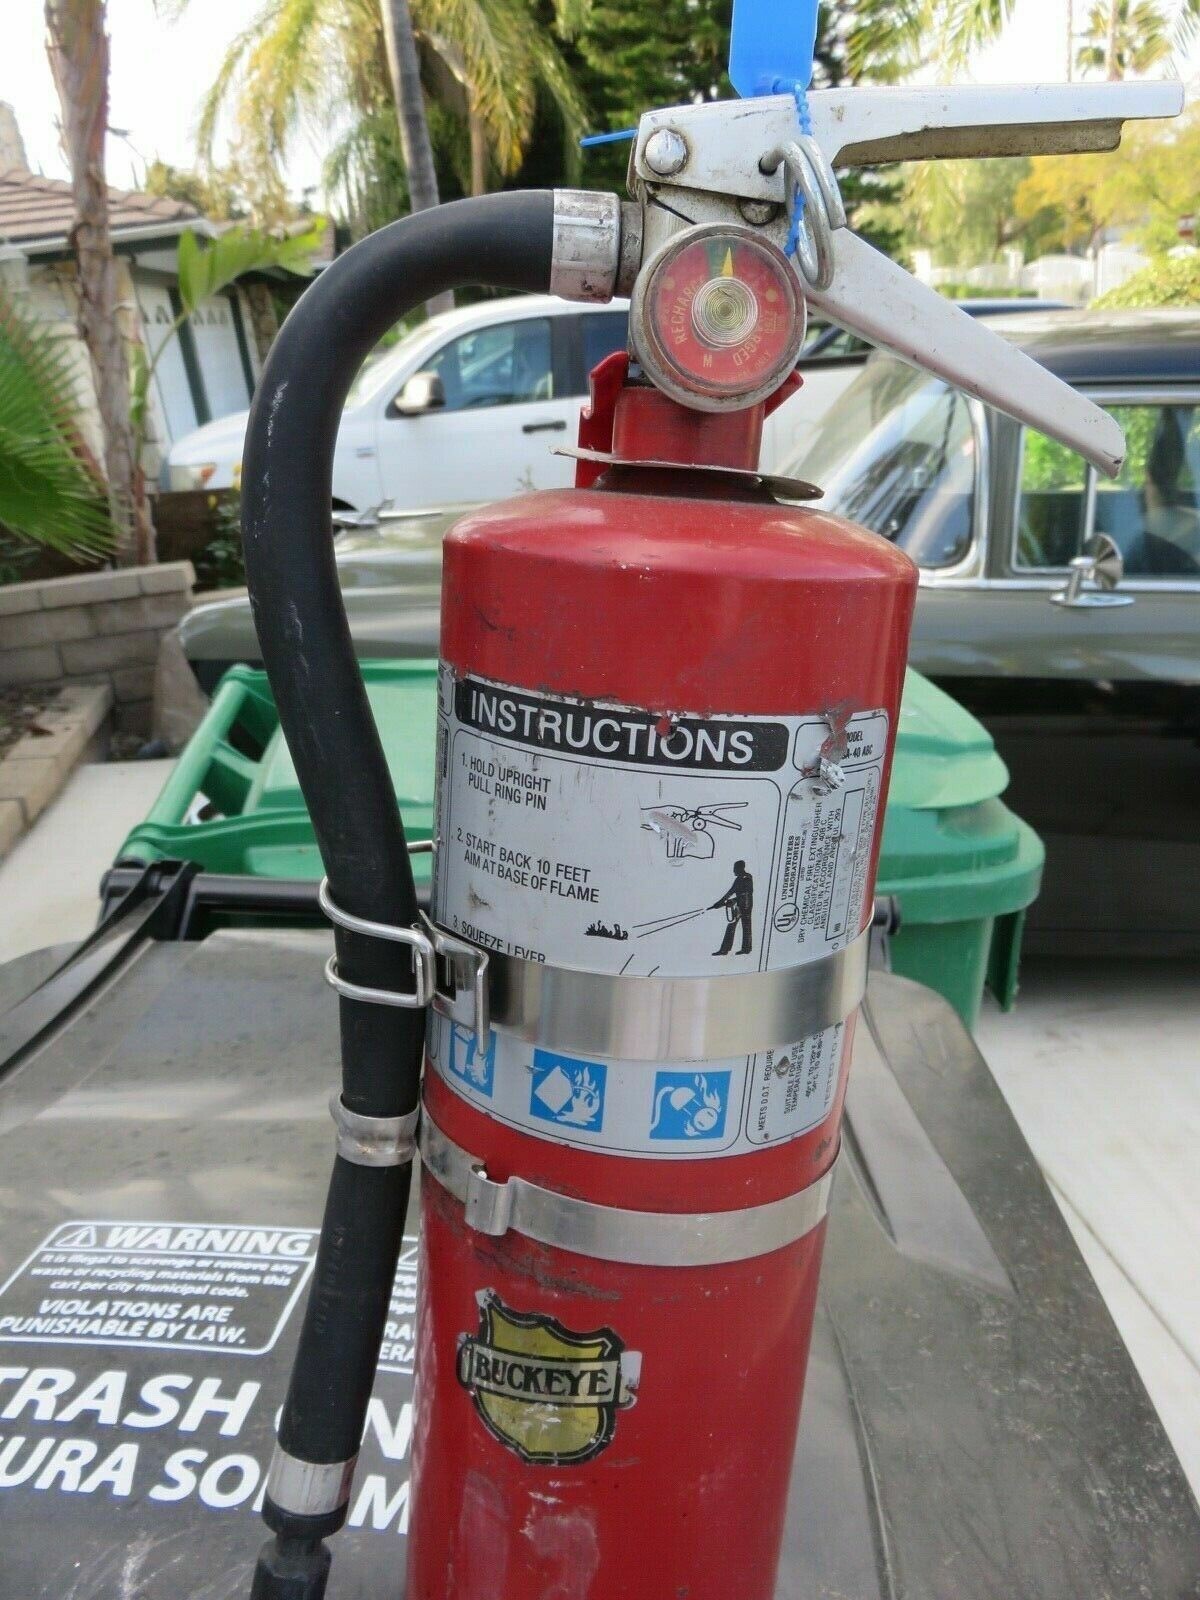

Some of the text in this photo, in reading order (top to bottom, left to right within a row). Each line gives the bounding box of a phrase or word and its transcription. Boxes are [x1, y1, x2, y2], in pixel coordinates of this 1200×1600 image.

[471, 690, 753, 764] INSTRUCTIONS
[462, 752, 551, 793] 1. HOLD UPRIGHT
[468, 772, 547, 811] PULL RING PIN
[809, 801, 822, 861] EXTINGUISHER
[457, 827, 591, 883] 2. START BACK 10 FEET
[781, 835, 795, 900] UNDERWRITERS
[788, 836, 801, 898] LABORATORIES
[806, 864, 814, 881] FIRE
[813, 810, 835, 930] TESTED IN ACCORDANCE WITH
[463, 849, 600, 903] AIM AT BASE OF FLAME
[807, 858, 821, 925] CLASSIFICATION
[800, 885, 811, 925] CHEMICAL
[820, 896, 830, 929] ANSI/UL
[784, 1046, 799, 1114] SUITABLE FOR USE
[790, 1054, 804, 1112] TEMPERATURES
[758, 1105, 767, 1131] MEETS
[105, 1226, 313, 1256] WARNING
[31, 1267, 292, 1287] waste or recycling materials from this
[66, 1254, 112, 1266] illegal
[111, 1255, 129, 1265] to
[128, 1256, 196, 1269] scavenge
[195, 1259, 214, 1268] or
[213, 1260, 270, 1271] remove
[269, 1262, 300, 1275] any
[49, 1280, 249, 1298] cart per city municipal code.
[0, 1315, 247, 1345] PUNISHABLE BY LAW.
[38, 1299, 235, 1323] VIOLATIONS ARE
[475, 1350, 613, 1397] BUCKEYE
